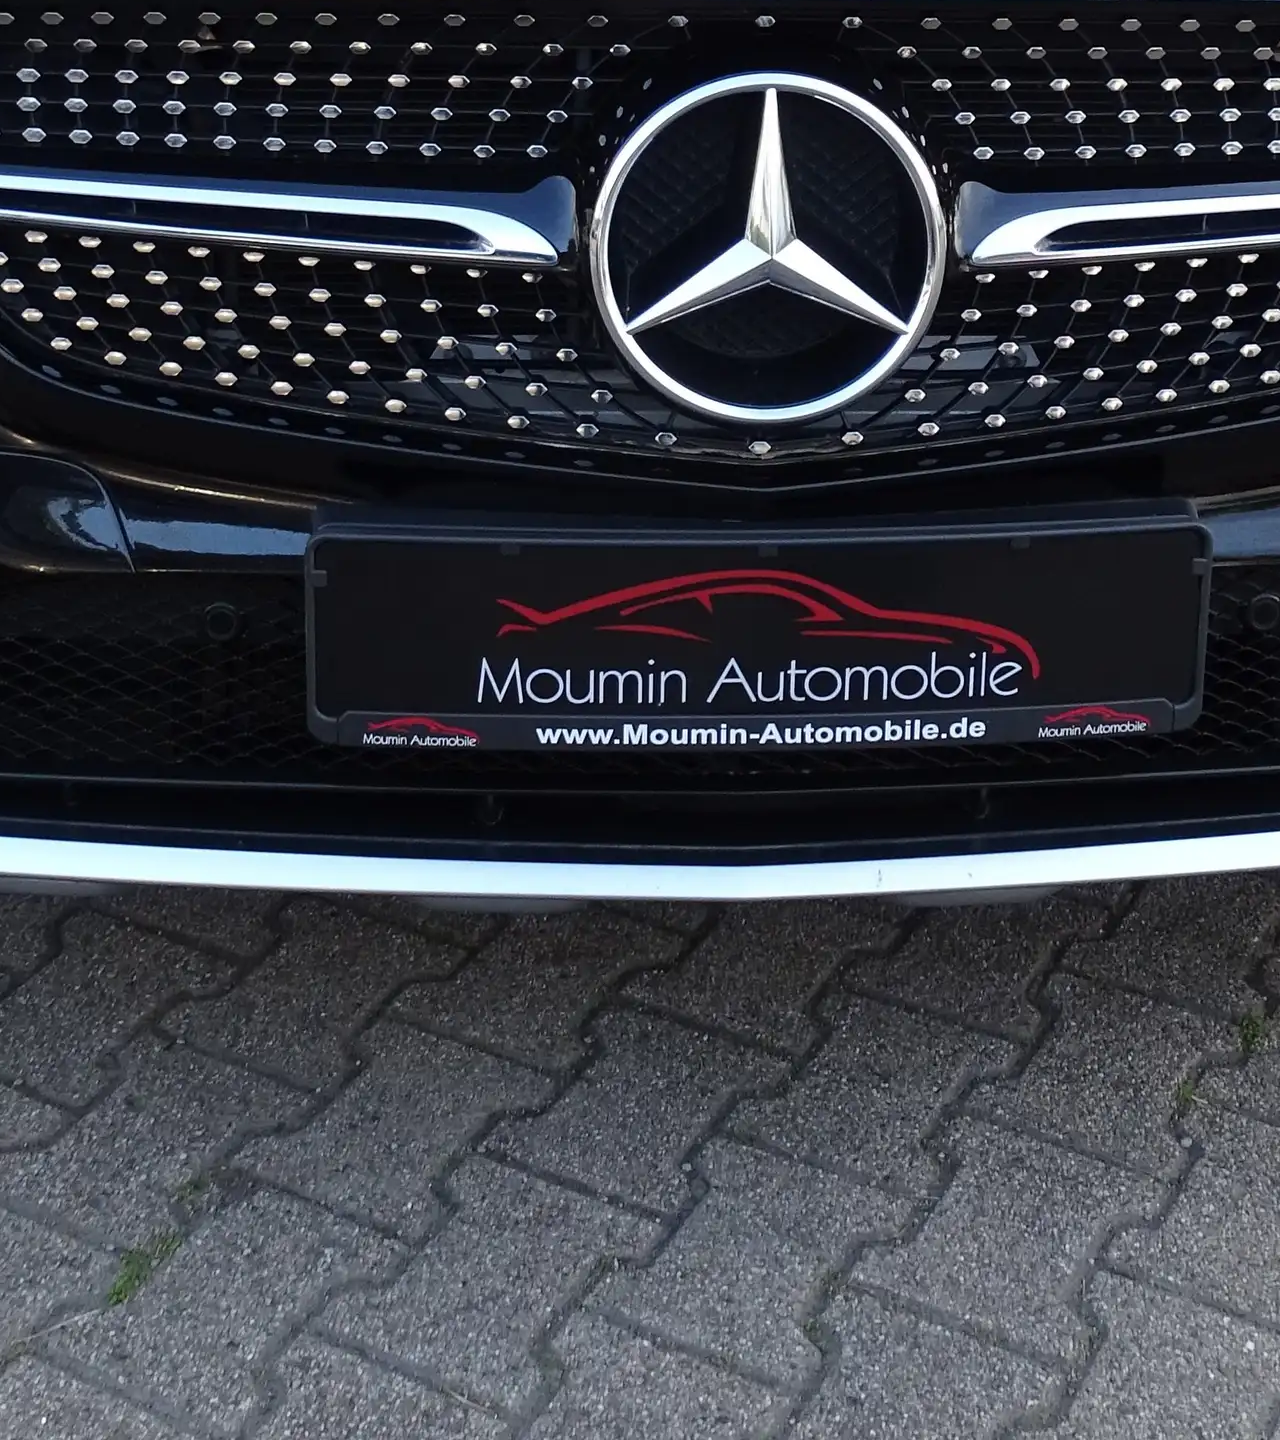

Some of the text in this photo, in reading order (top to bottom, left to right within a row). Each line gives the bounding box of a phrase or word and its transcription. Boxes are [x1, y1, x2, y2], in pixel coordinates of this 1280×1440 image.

[477, 651, 1022, 704] Moumin Automobile
[363, 733, 477, 747] Moumin Automobile
[536, 717, 986, 746] www.Moumin-Automobile.de
[1038, 721, 1147, 738] Moumin Automobile
